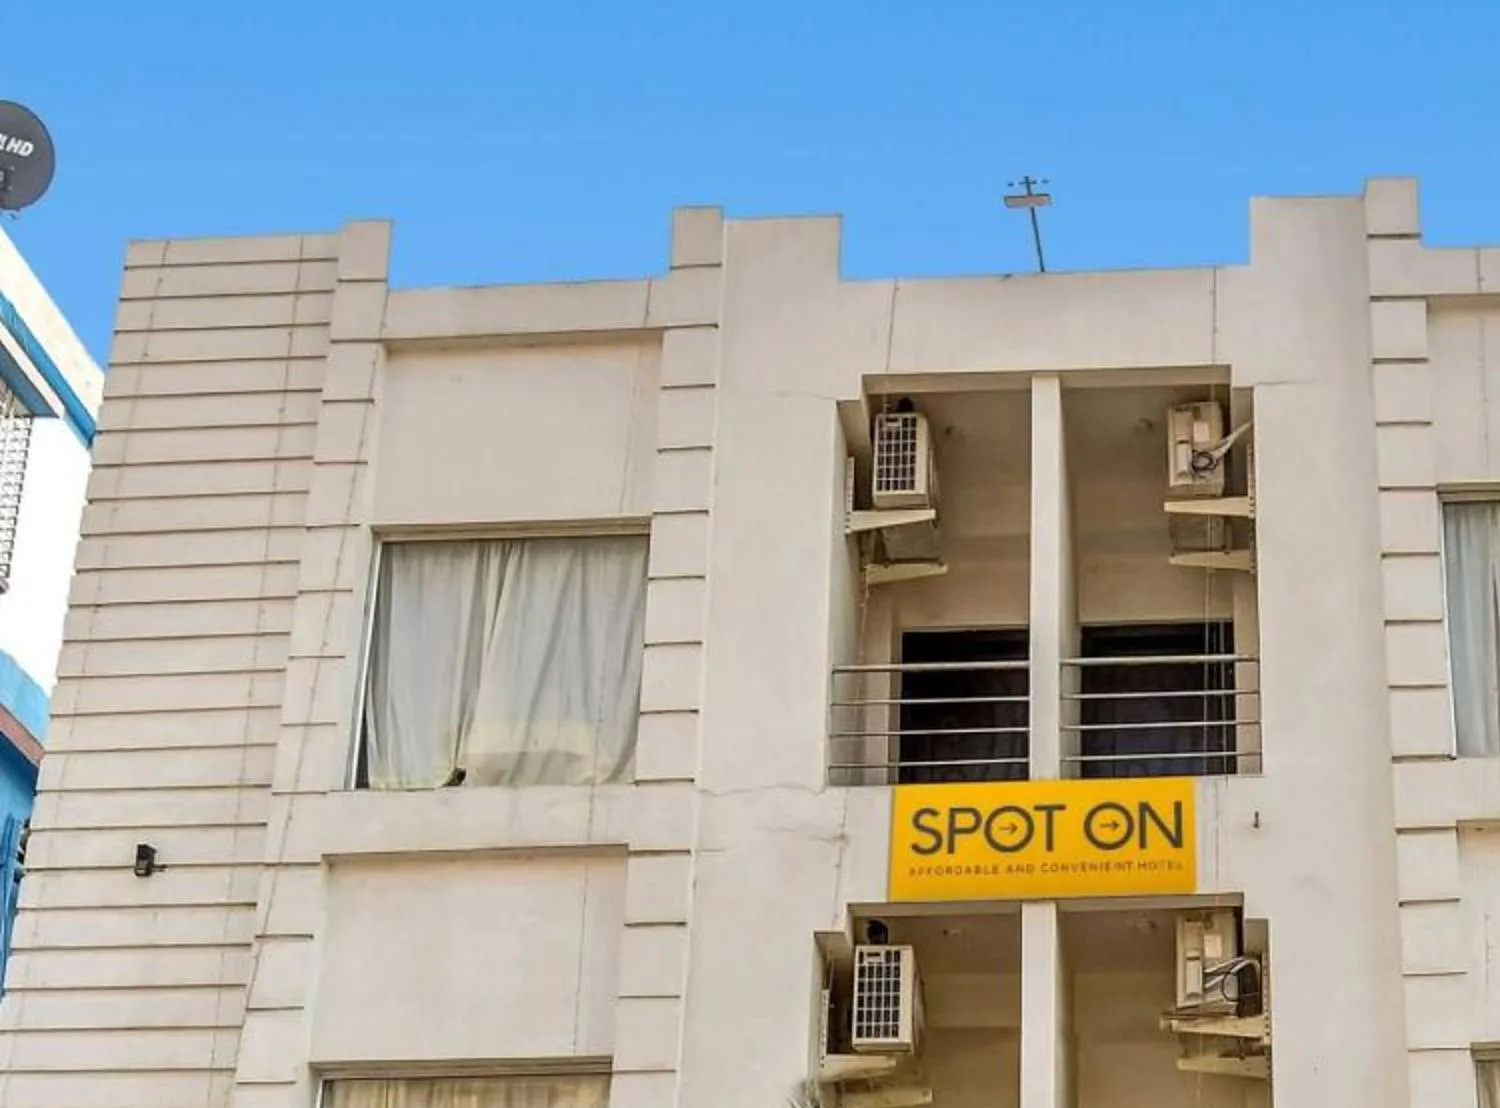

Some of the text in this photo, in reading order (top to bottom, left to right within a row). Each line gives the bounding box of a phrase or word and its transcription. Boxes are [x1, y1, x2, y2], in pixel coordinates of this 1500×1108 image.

[911, 801, 1183, 855] SPOT ON
[909, 864, 998, 877] AFFORDABLE
[1007, 864, 1036, 874] AND
[1138, 860, 1182, 871] HOTEL
